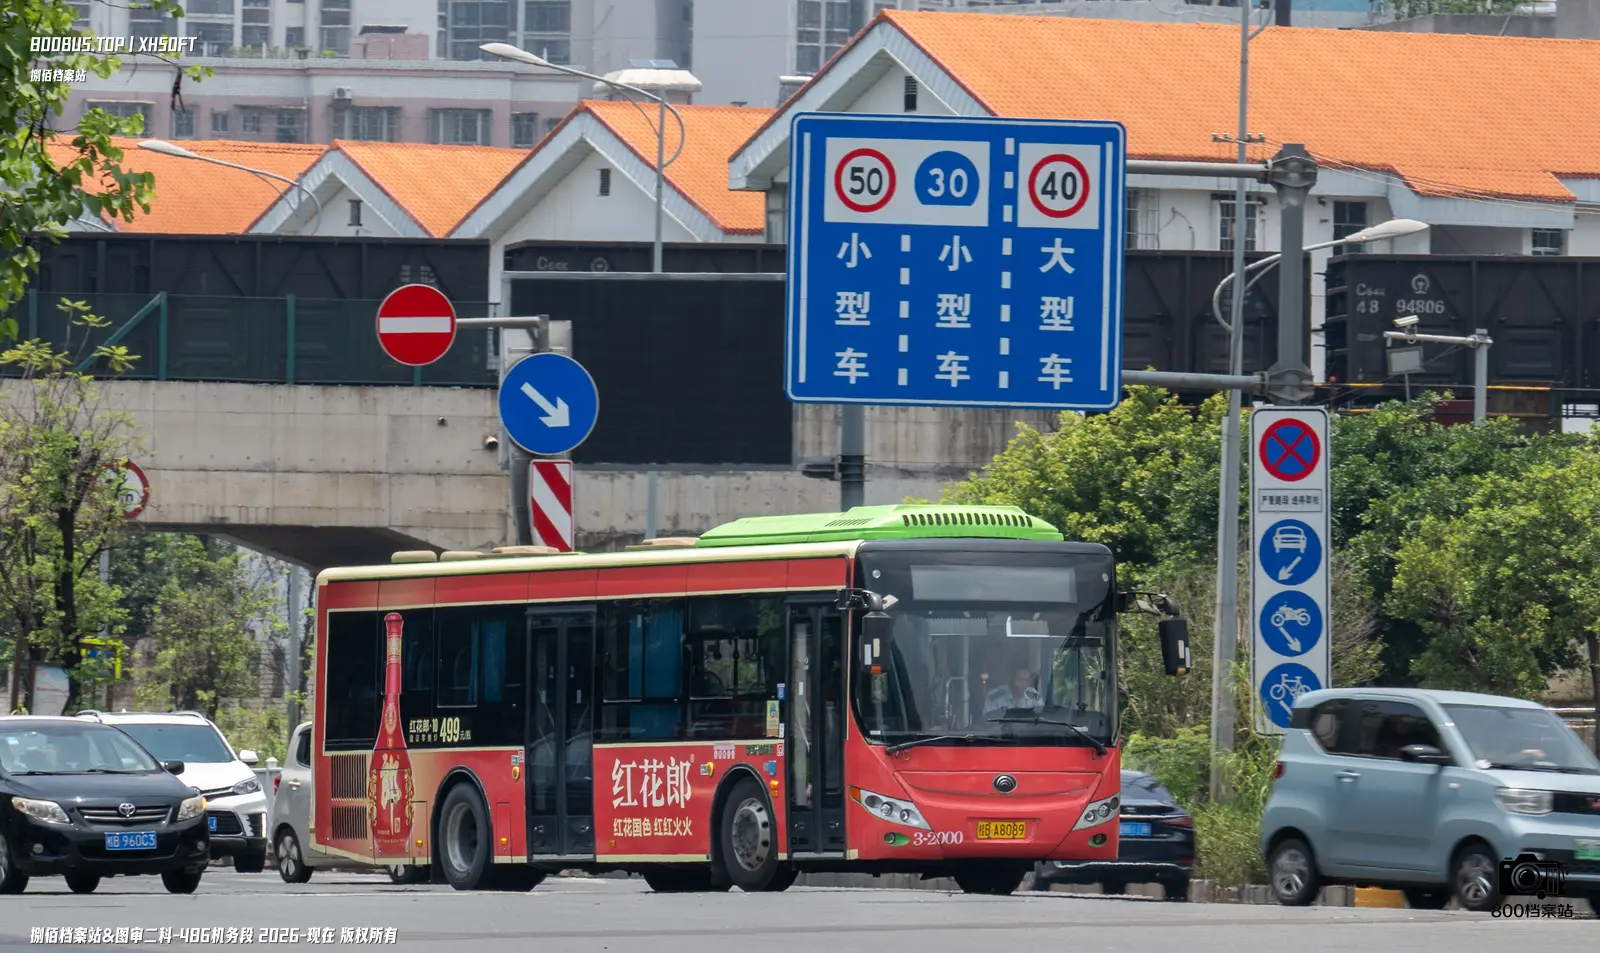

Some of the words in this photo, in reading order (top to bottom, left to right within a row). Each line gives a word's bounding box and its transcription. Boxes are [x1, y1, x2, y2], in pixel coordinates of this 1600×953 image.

[850, 166, 883, 196] 50
[927, 168, 968, 198] 30
[1041, 171, 1077, 200] 40
[833, 232, 873, 384] 小型车
[934, 235, 973, 388] 小型车
[1037, 237, 1076, 390] 大型车
[1395, 299, 1445, 314] 94806
[611, 756, 692, 809] 红花郎
[613, 817, 652, 837] 红花国色
[653, 816, 693, 837] 红红火火
[913, 830, 964, 846] 3-2000
